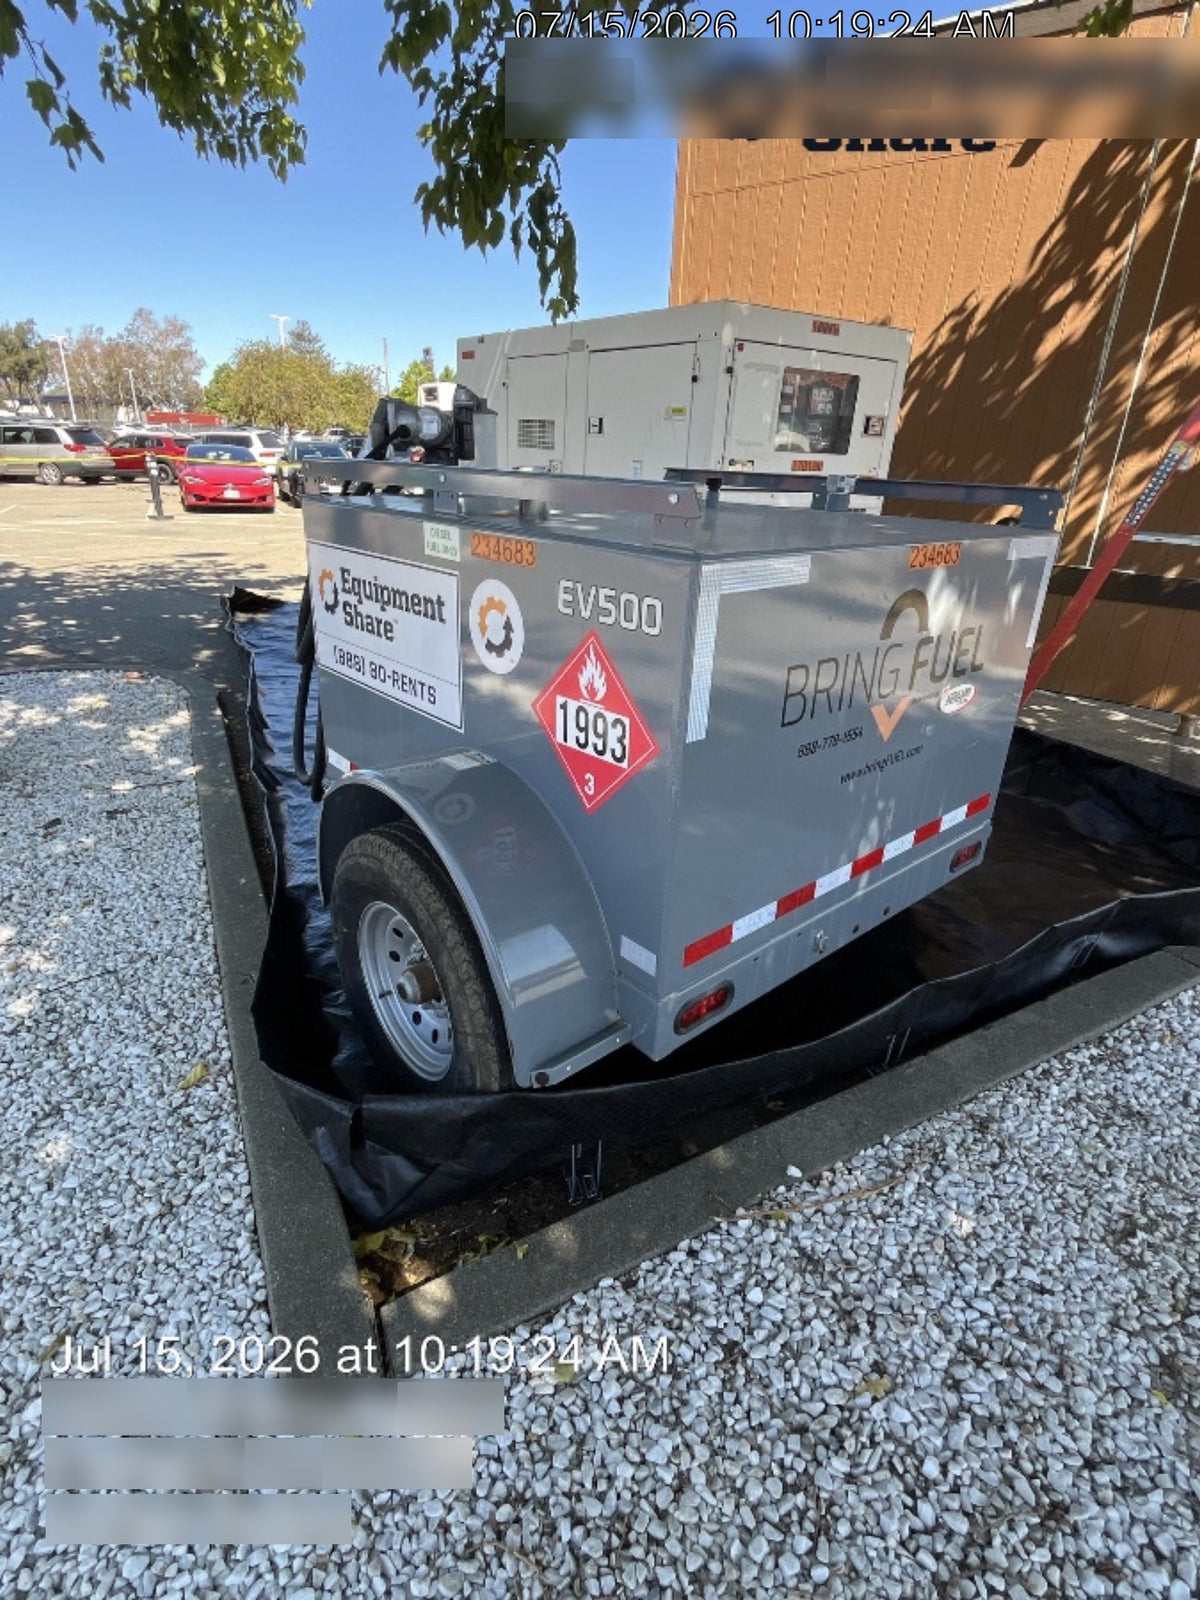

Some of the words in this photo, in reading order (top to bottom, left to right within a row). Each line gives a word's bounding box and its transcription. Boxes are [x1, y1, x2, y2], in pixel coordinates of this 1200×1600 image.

[472, 533, 536, 567] 234683
[340, 566, 447, 624] Equipment
[342, 600, 395, 643] Share
[558, 578, 664, 637] EV500
[333, 645, 366, 677] (888)
[368, 660, 438, 706] 80-RENTS
[780, 642, 904, 728] BRING
[908, 625, 985, 691] FUEL
[559, 699, 627, 764] 1993
[584, 772, 596, 796] 3
